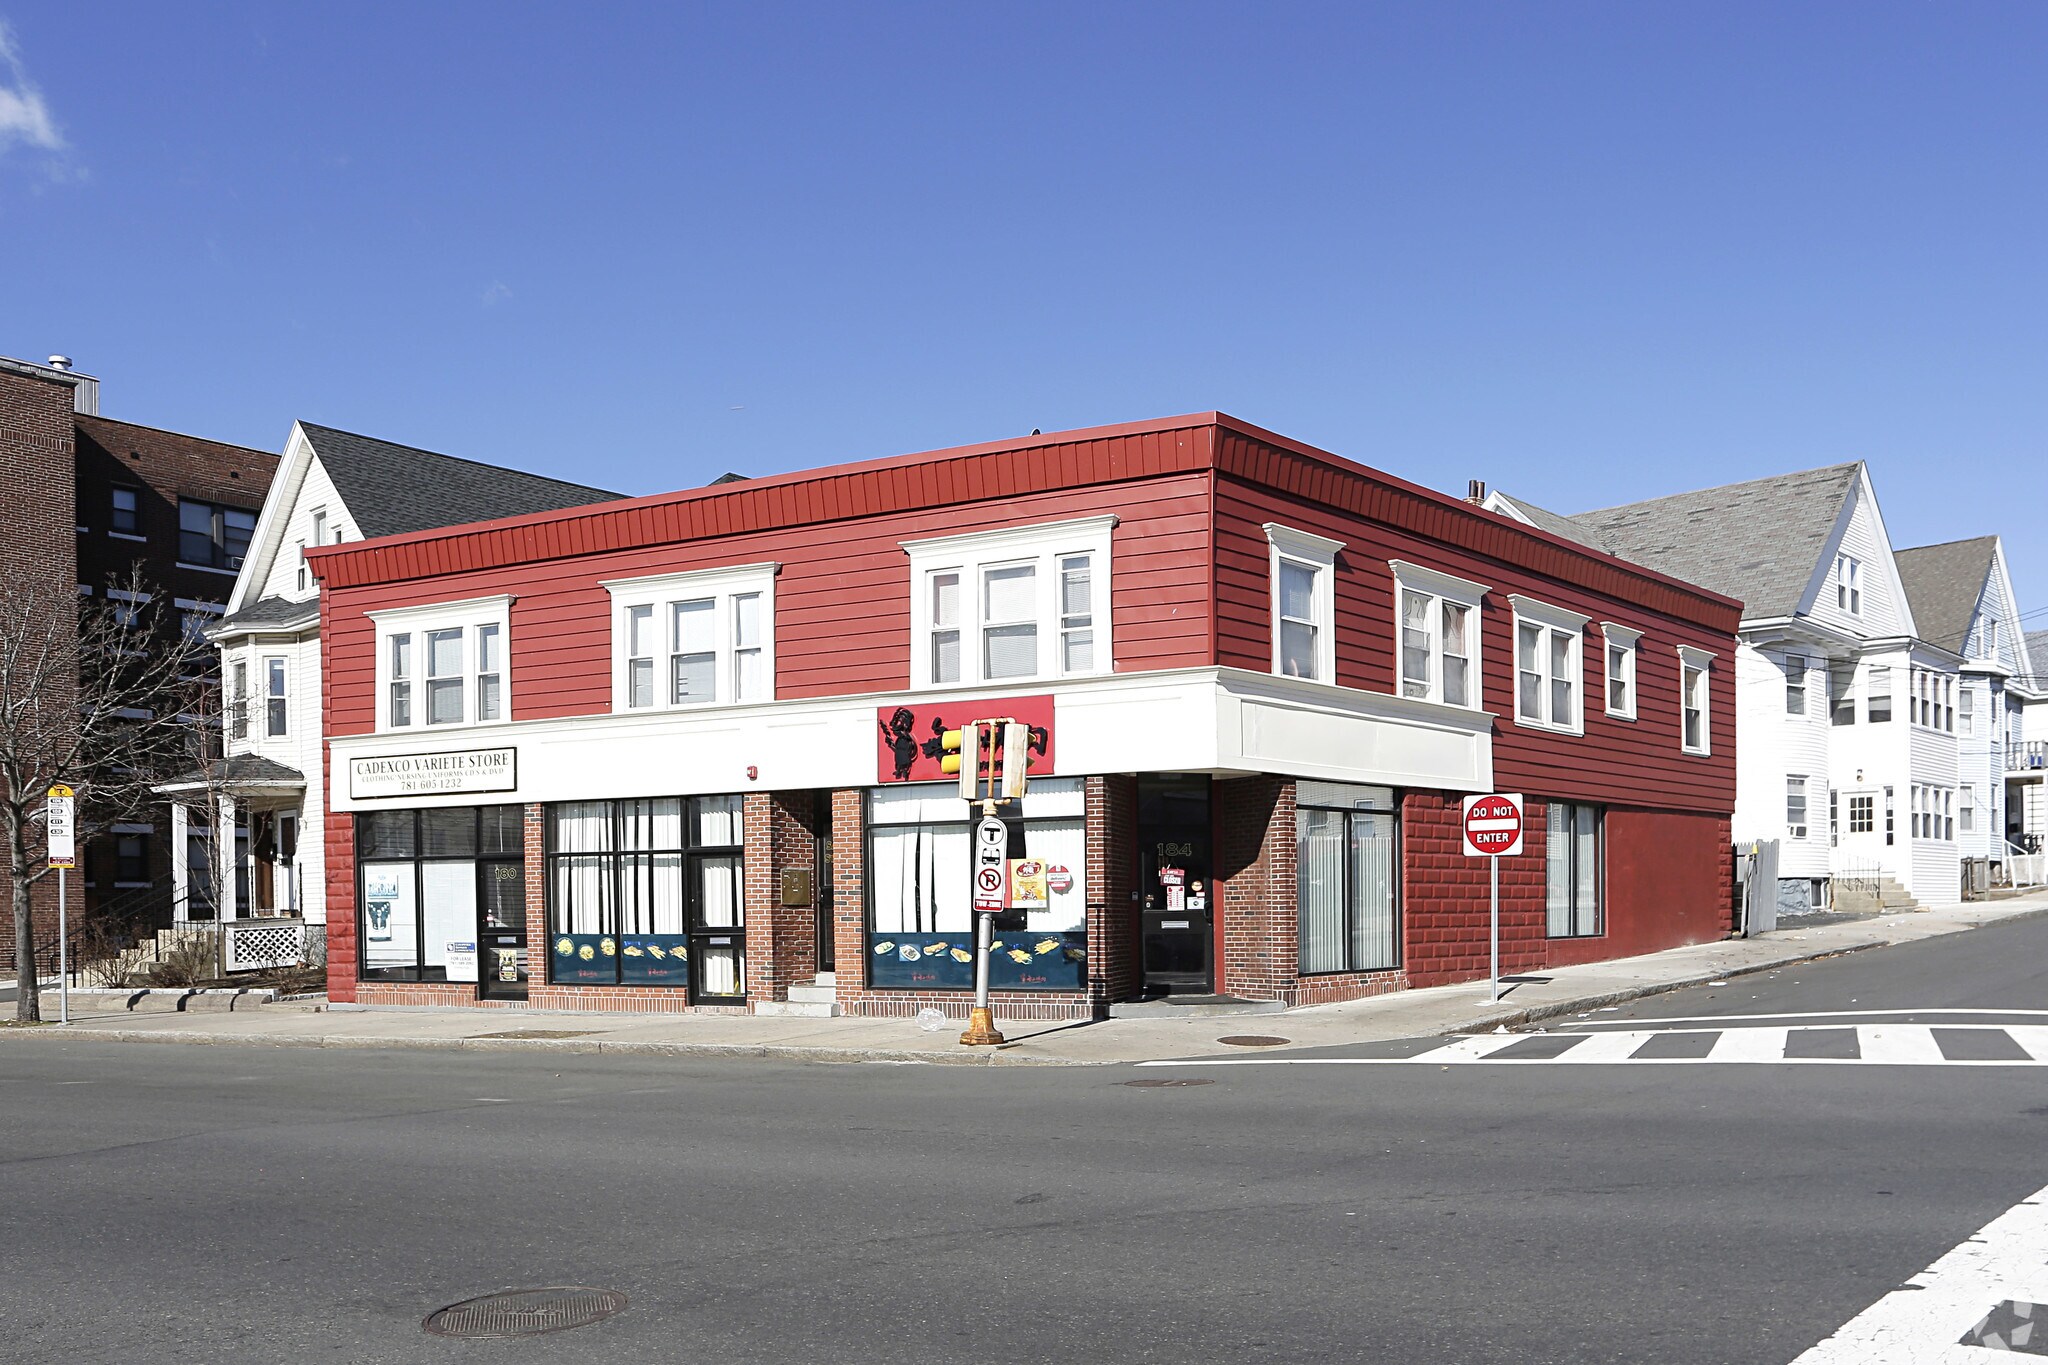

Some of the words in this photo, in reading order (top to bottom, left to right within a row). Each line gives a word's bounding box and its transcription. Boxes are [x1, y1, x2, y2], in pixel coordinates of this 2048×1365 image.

[357, 760, 410, 775] CADEXCO
[414, 756, 465, 771] VARIETE
[469, 753, 509, 768] STORE
[428, 771, 464, 779] UNIFORMS
[1473, 807, 1487, 818] DO
[1493, 806, 1513, 817] NOT
[984, 827, 1001, 842] T
[1476, 832, 1509, 843] ENTER
[1157, 842, 1192, 857] 184
[495, 867, 517, 880] 180
